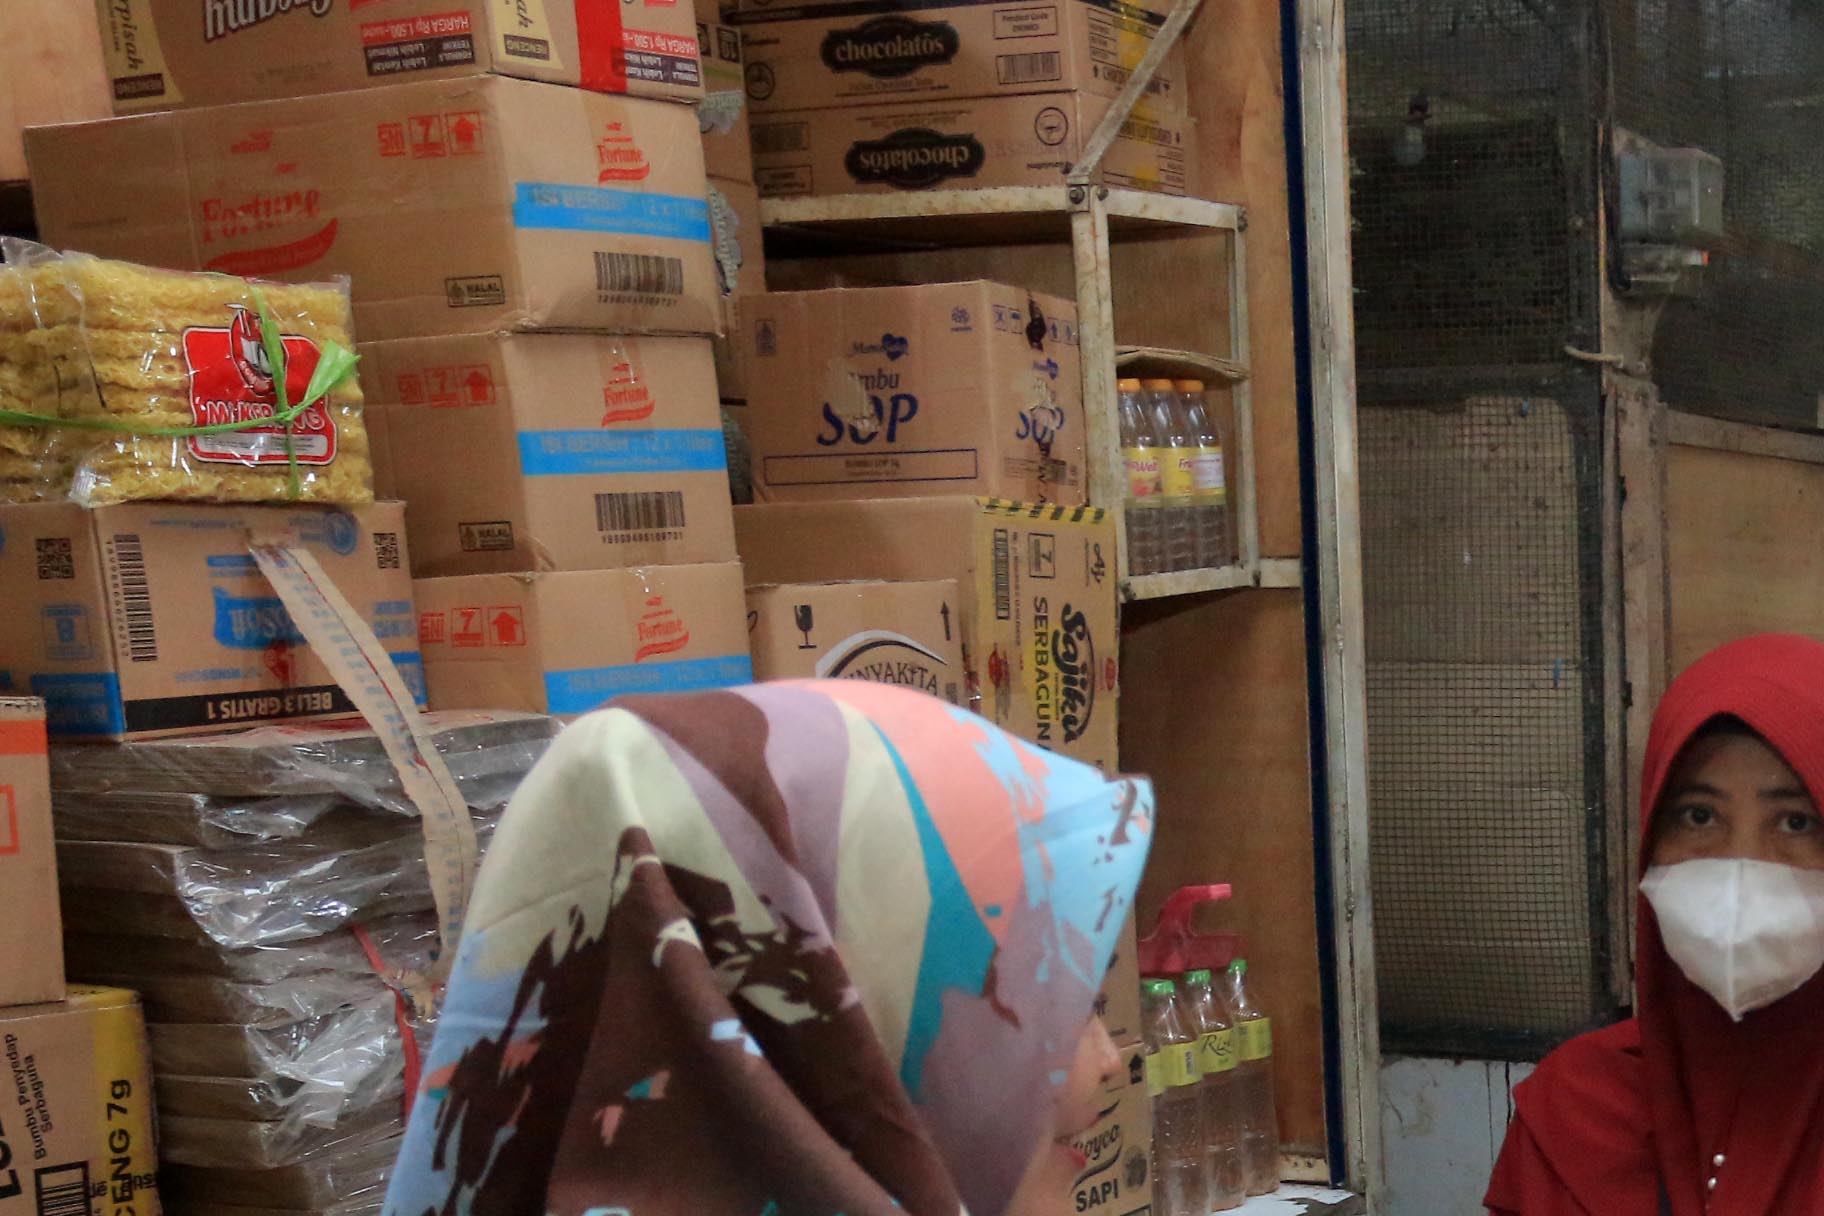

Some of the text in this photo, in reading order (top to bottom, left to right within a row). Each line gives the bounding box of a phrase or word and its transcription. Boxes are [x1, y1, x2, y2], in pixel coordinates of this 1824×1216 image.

[415, 18, 430, 34] Rp
[430, 16, 469, 32] HARGA
[654, 36, 667, 51] Rp
[666, 37, 696, 54] HARGA
[417, 117, 433, 145] 7
[597, 144, 644, 164] Fortune
[467, 282, 501, 295] HALAL
[603, 386, 649, 407] Fortune
[458, 609, 477, 632] 7
[636, 619, 684, 642] Fortune
[846, 662, 938, 697] NYAKITA
[1033, 596, 1052, 752] SERBAGUN
[1053, 602, 1089, 745] Sajiku
[220, 694, 282, 717] GRATIS
[284, 694, 296, 714] 3
[298, 691, 333, 714] BELI
[23, 1054, 54, 1133] Serbaguna
[107, 1078, 132, 1124] 7g
[26, 1109, 49, 1160] Bumbu
[1078, 1124, 1121, 1160] oyco
[1075, 1179, 1120, 1213] SAPI
